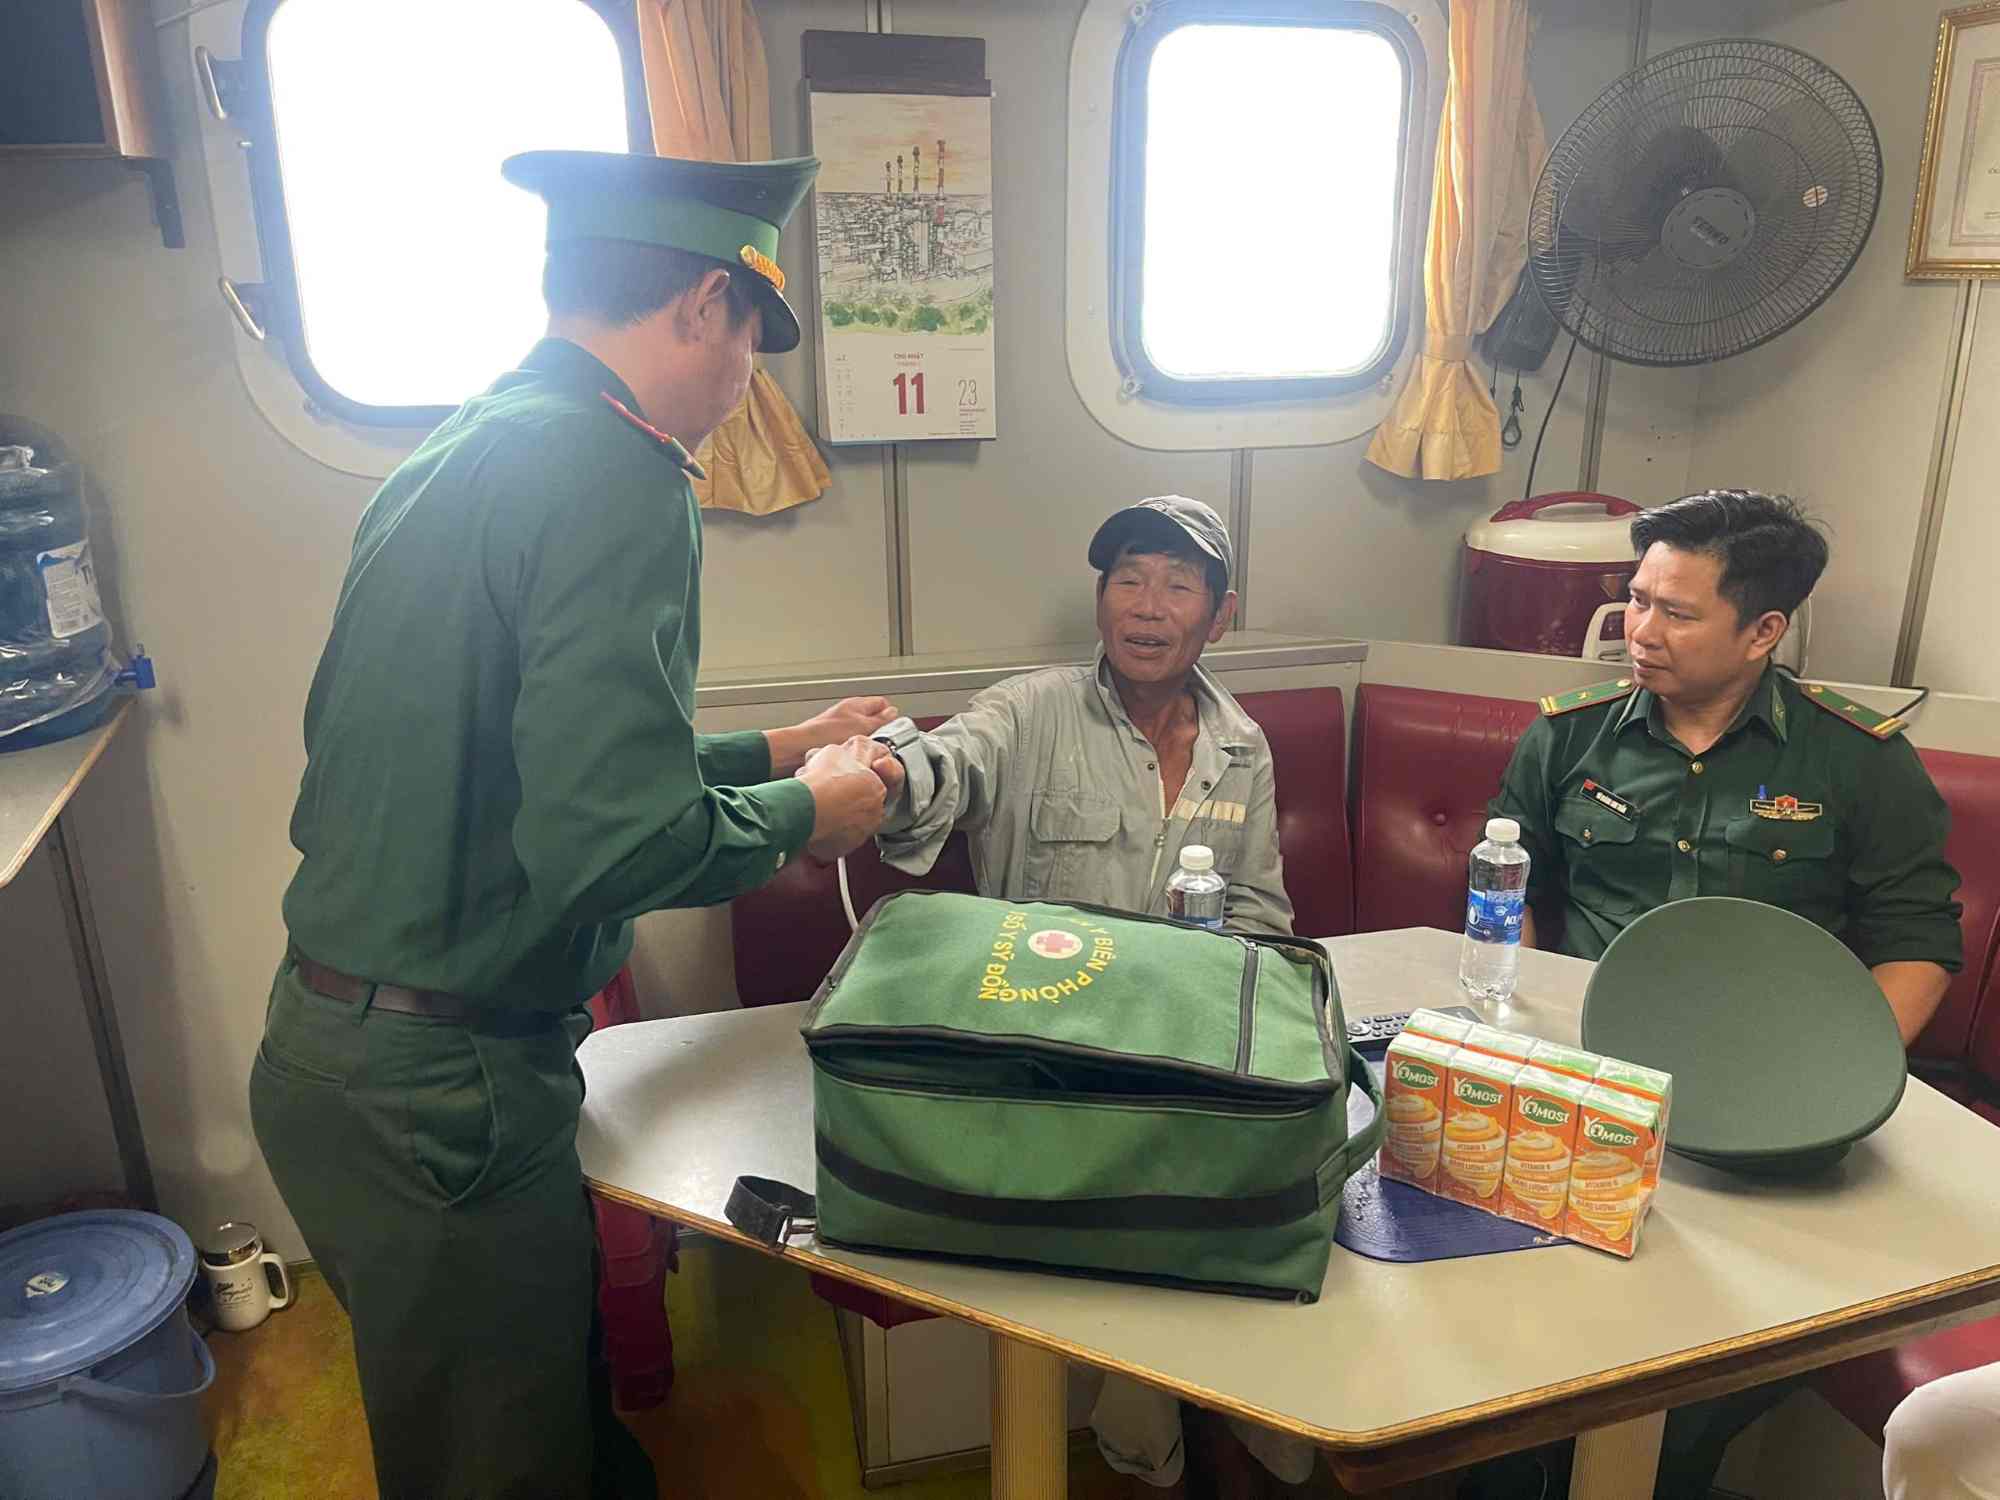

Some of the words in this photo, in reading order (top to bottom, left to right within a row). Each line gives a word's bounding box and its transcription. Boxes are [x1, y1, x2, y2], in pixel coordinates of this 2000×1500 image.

[893, 372, 925, 415] 11
[958, 379, 977, 406] 23
[1086, 937, 1117, 972] BIÊN
[998, 970, 1094, 1004] PHÒNG
